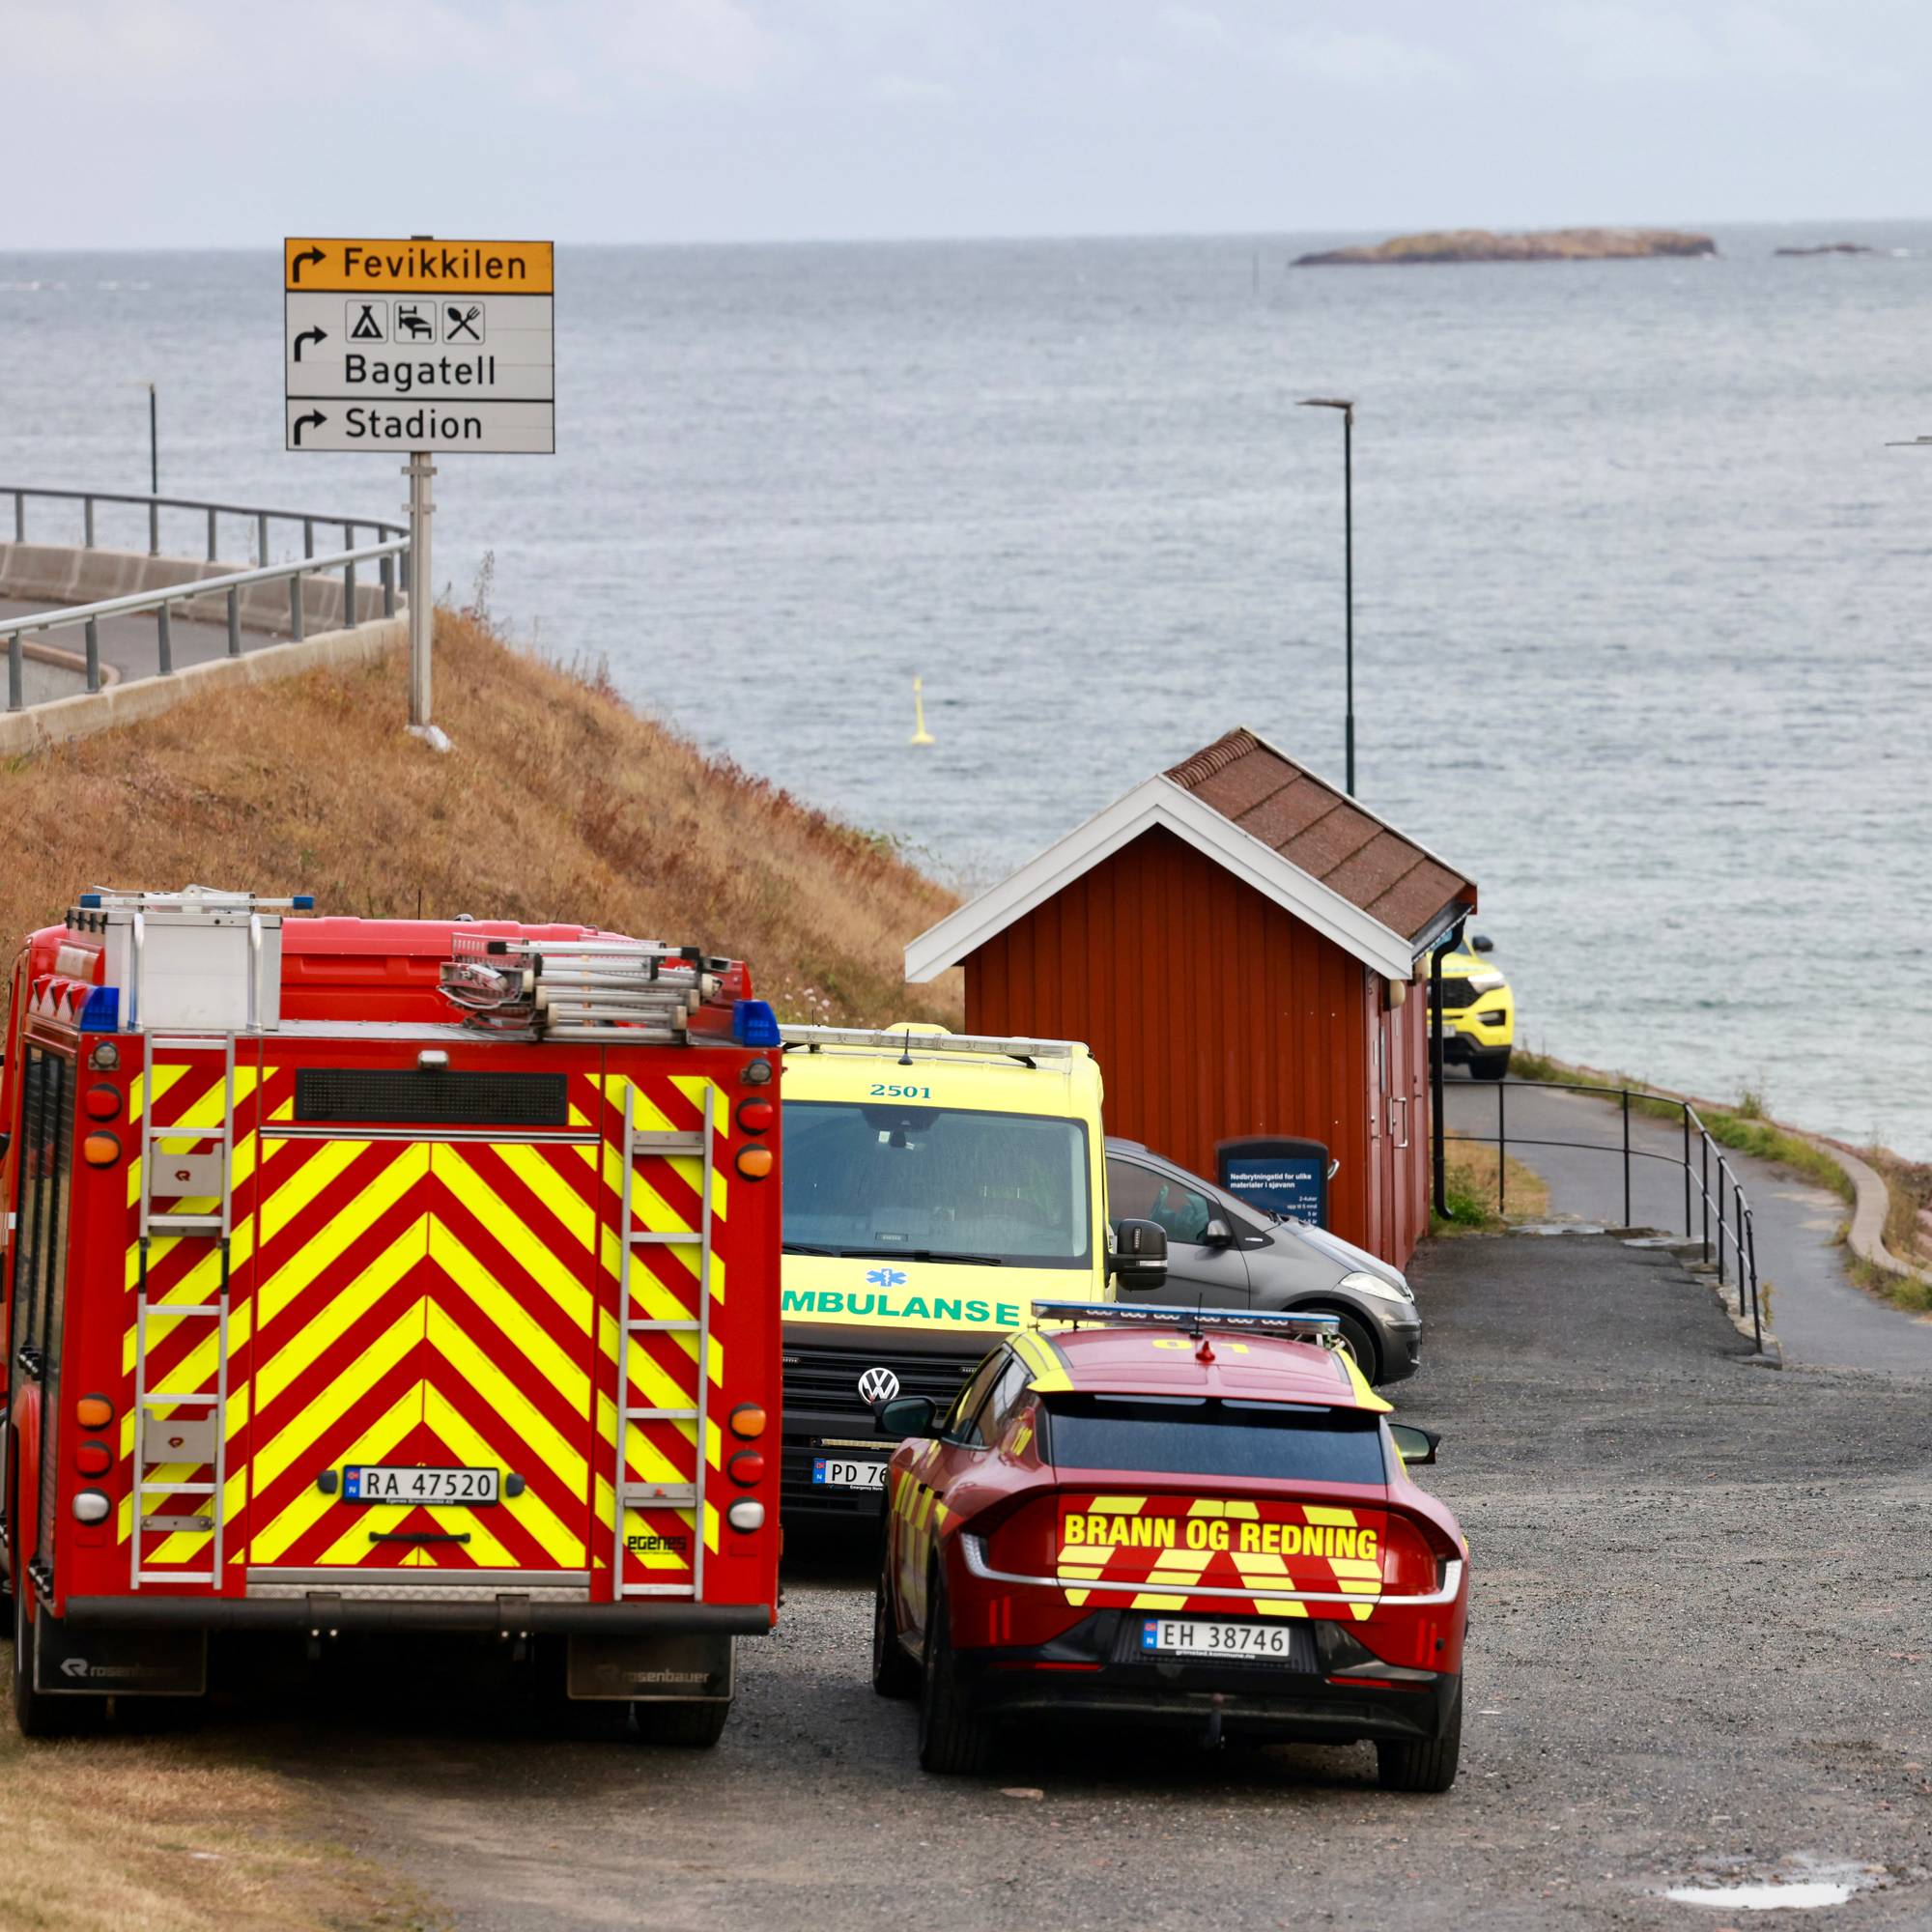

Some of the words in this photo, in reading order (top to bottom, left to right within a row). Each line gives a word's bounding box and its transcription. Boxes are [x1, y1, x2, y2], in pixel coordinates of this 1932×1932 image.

[344, 247, 526, 279] Fevikkilen
[345, 354, 495, 392] Bagatell
[345, 408, 482, 439] Stadion
[869, 1083, 931, 1098] 2501
[1230, 1173, 1284, 1181] Nedbrytningstid
[1268, 1181, 1295, 1190] sjøvann
[781, 1290, 1021, 1327] MBULANSE
[367, 1472, 399, 1495] RA
[412, 1473, 491, 1497] 47520
[832, 1463, 858, 1483] PD
[867, 1465, 889, 1485] 76
[1065, 1514, 1176, 1548] BRANN
[1186, 1518, 1230, 1551] OG
[1239, 1521, 1378, 1561] REDNING
[1164, 1624, 1194, 1646] EH
[1208, 1626, 1284, 1652] 38746
